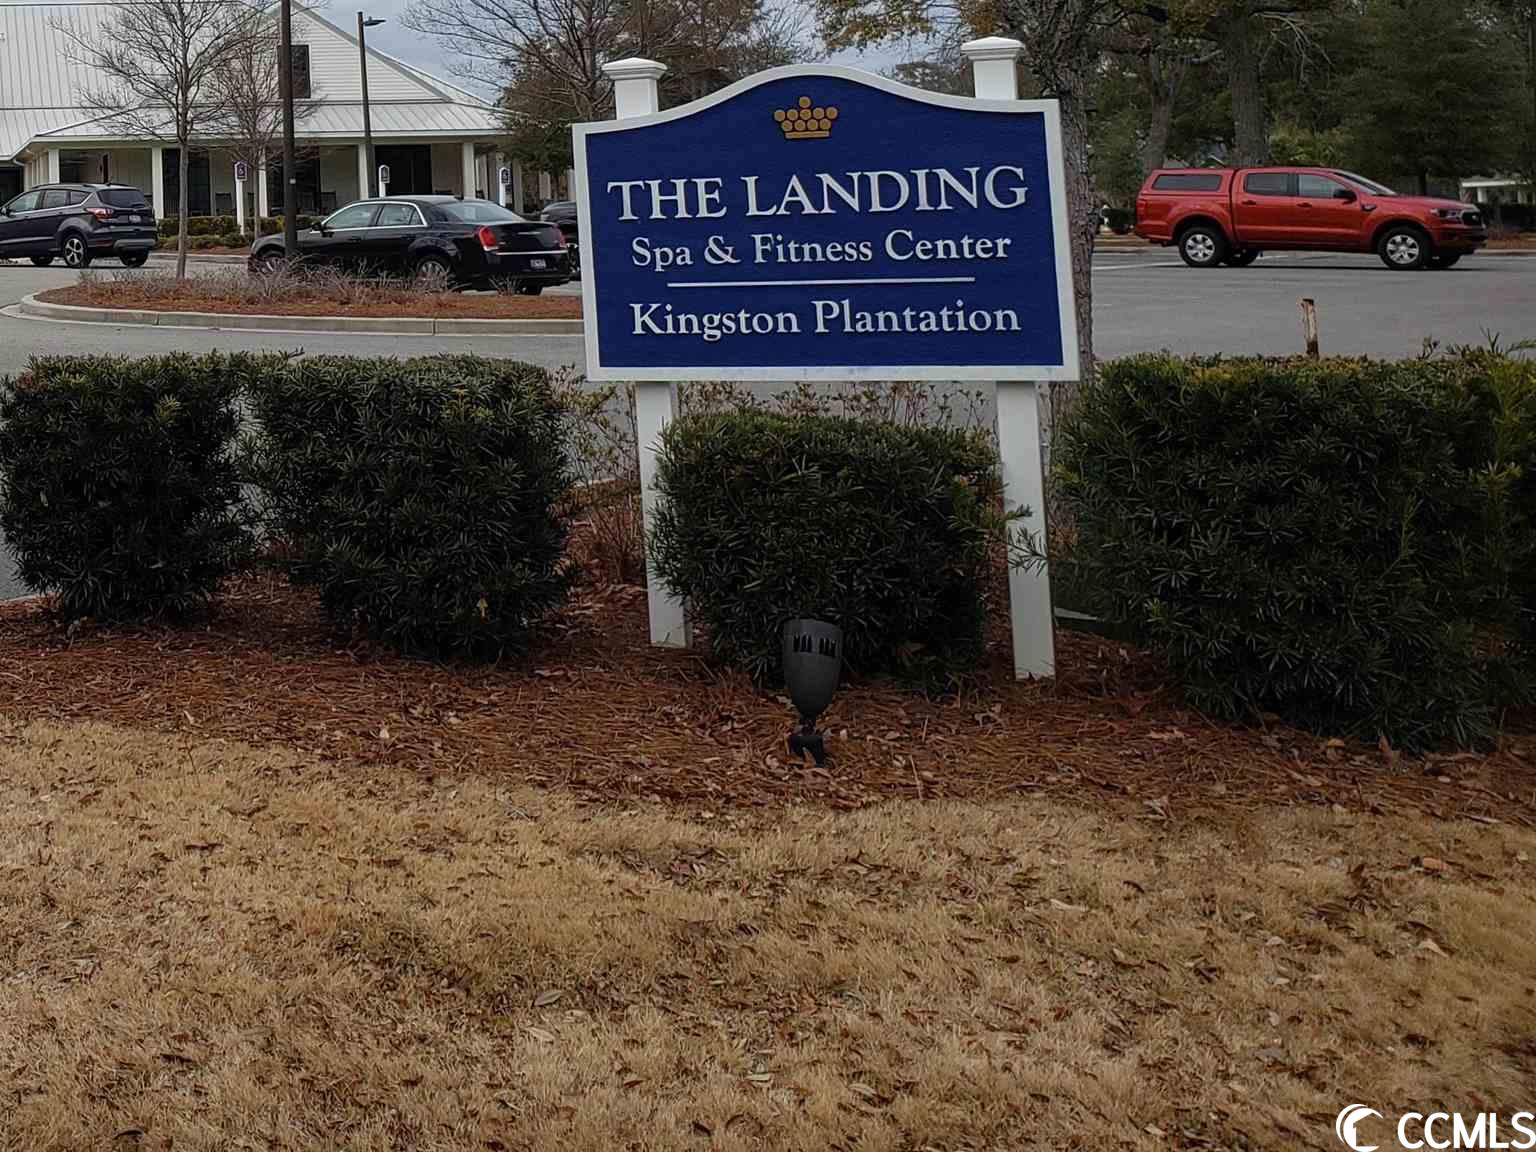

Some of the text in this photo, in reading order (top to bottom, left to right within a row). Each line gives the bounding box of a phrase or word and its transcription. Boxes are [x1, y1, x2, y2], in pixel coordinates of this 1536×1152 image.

[607, 165, 1028, 220] THE LANDING
[632, 229, 1011, 272] Spa & Fitness Center
[629, 299, 1021, 341] Kingston Plantation
